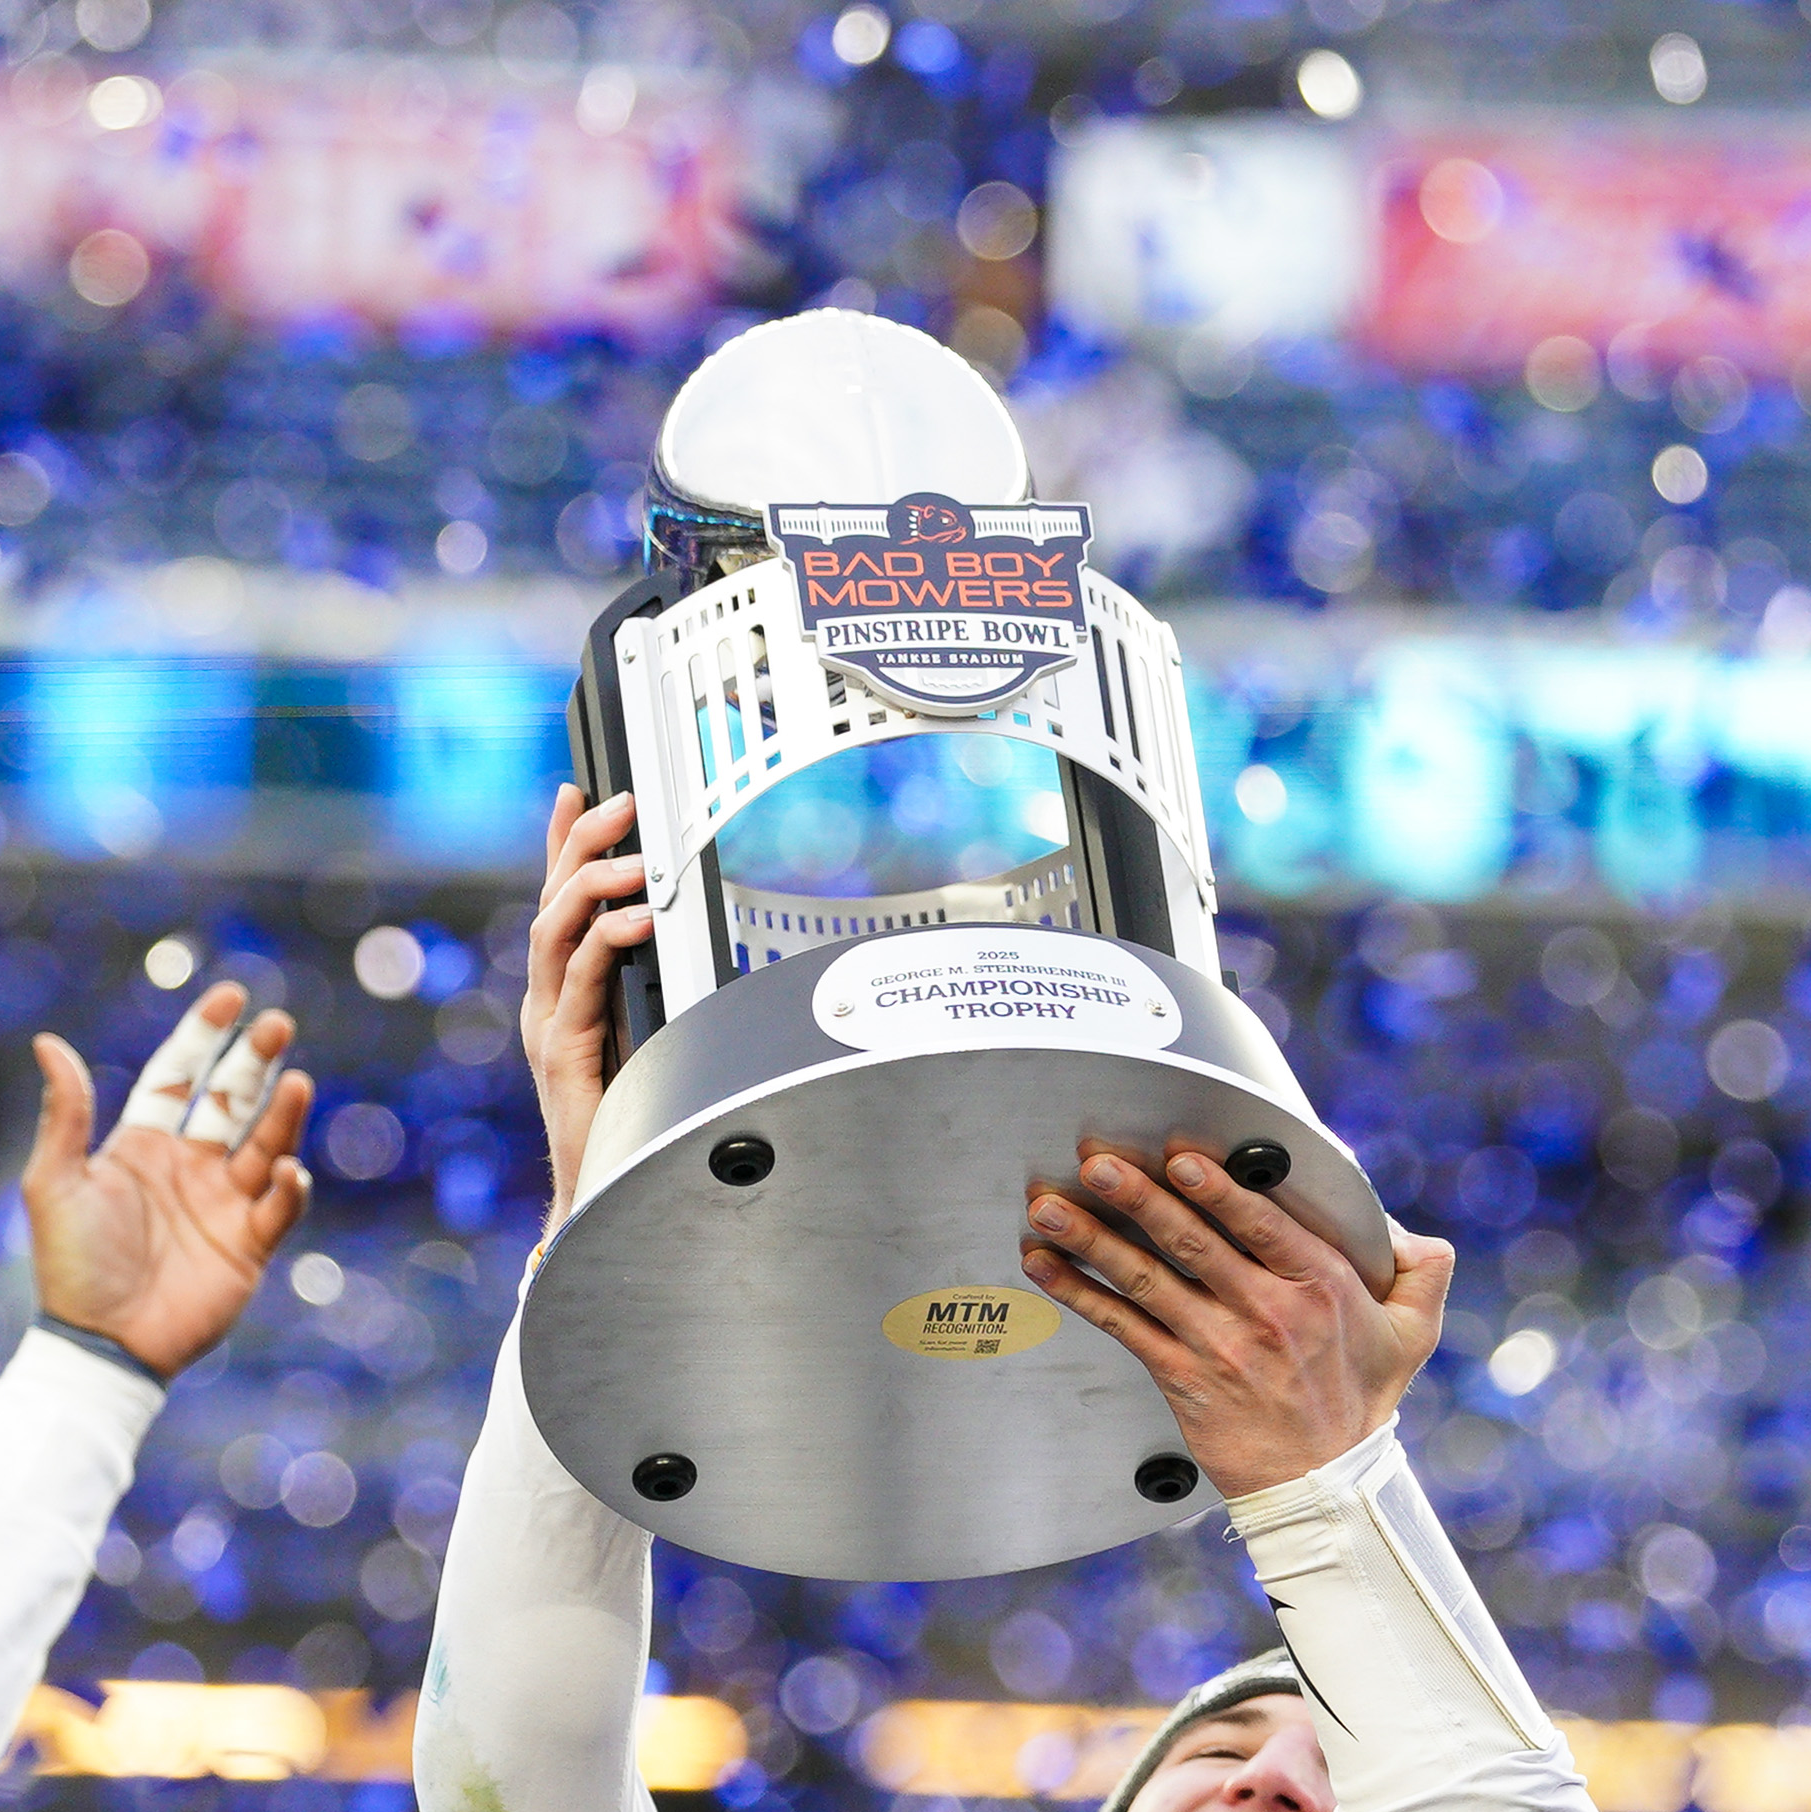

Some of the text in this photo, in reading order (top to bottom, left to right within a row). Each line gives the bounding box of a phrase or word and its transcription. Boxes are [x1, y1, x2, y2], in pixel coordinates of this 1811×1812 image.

[803, 552, 1065, 578] BAD BOY
[806, 579, 1074, 608] MOWERS
[825, 619, 1070, 648] PINSTRIPE BOWL
[875, 652, 1025, 665] YANKEE STADIUM
[976, 951, 1020, 961] 2025
[870, 964, 1128, 988] GEORGE M. STEINBRENNER III
[875, 979, 1132, 1009] CHAMPIONSHIP
[944, 1001, 1077, 1020] TROPHY
[926, 1302, 1010, 1322] MTM
